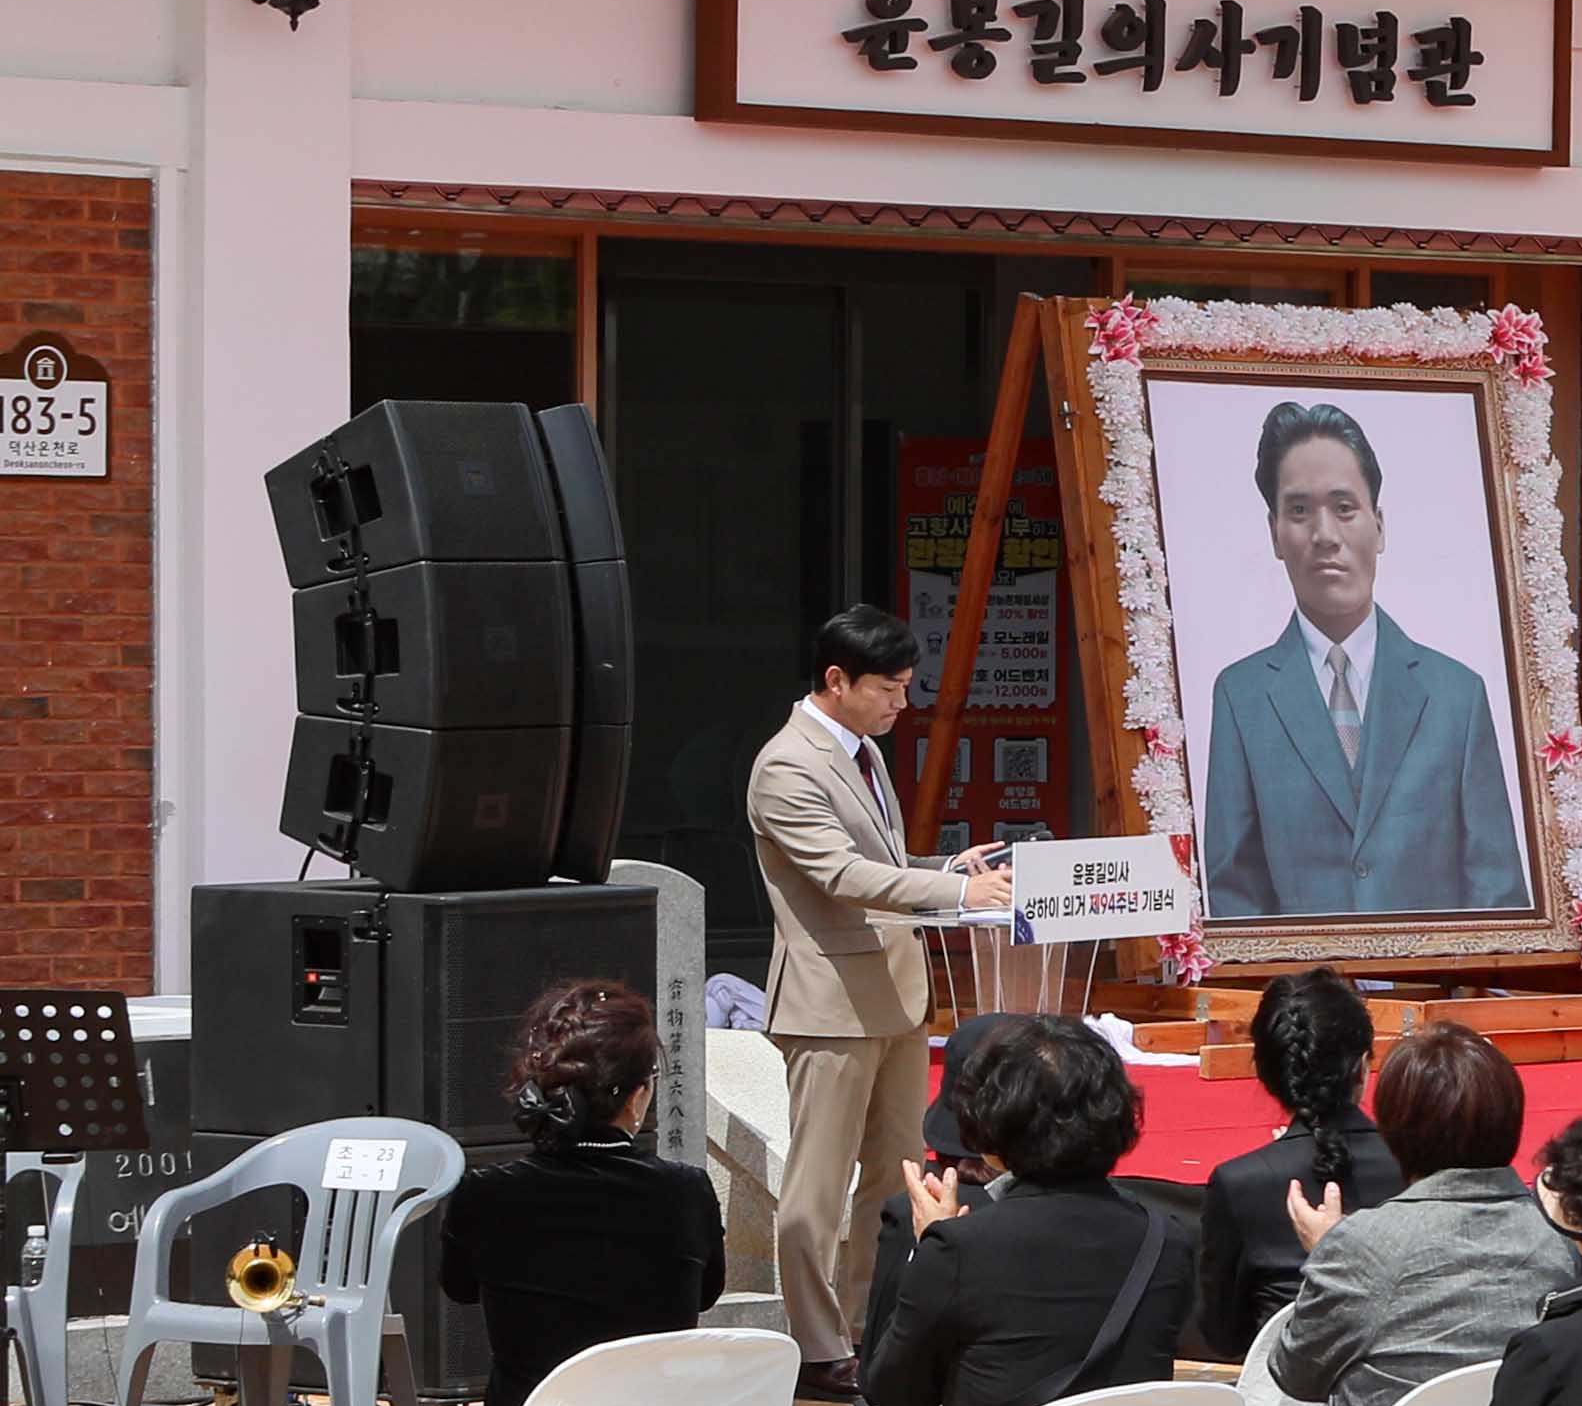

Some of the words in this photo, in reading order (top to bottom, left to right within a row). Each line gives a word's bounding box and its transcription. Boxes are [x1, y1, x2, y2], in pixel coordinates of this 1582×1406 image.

[9, 440, 80, 457] 덕산온천로
[993, 631, 1049, 645] 모노레일
[993, 668, 1049, 683] 어드벤처
[1072, 860, 1130, 886] 윤봉길의사
[1024, 896, 1060, 921] 상하이
[1062, 894, 1087, 917] 의거
[1088, 891, 1139, 915] 제94주년
[1141, 888, 1175, 912] 기념식
[336, 1145, 353, 1160] 초
[376, 1147, 395, 1162] 23
[335, 1165, 353, 1180] 고
